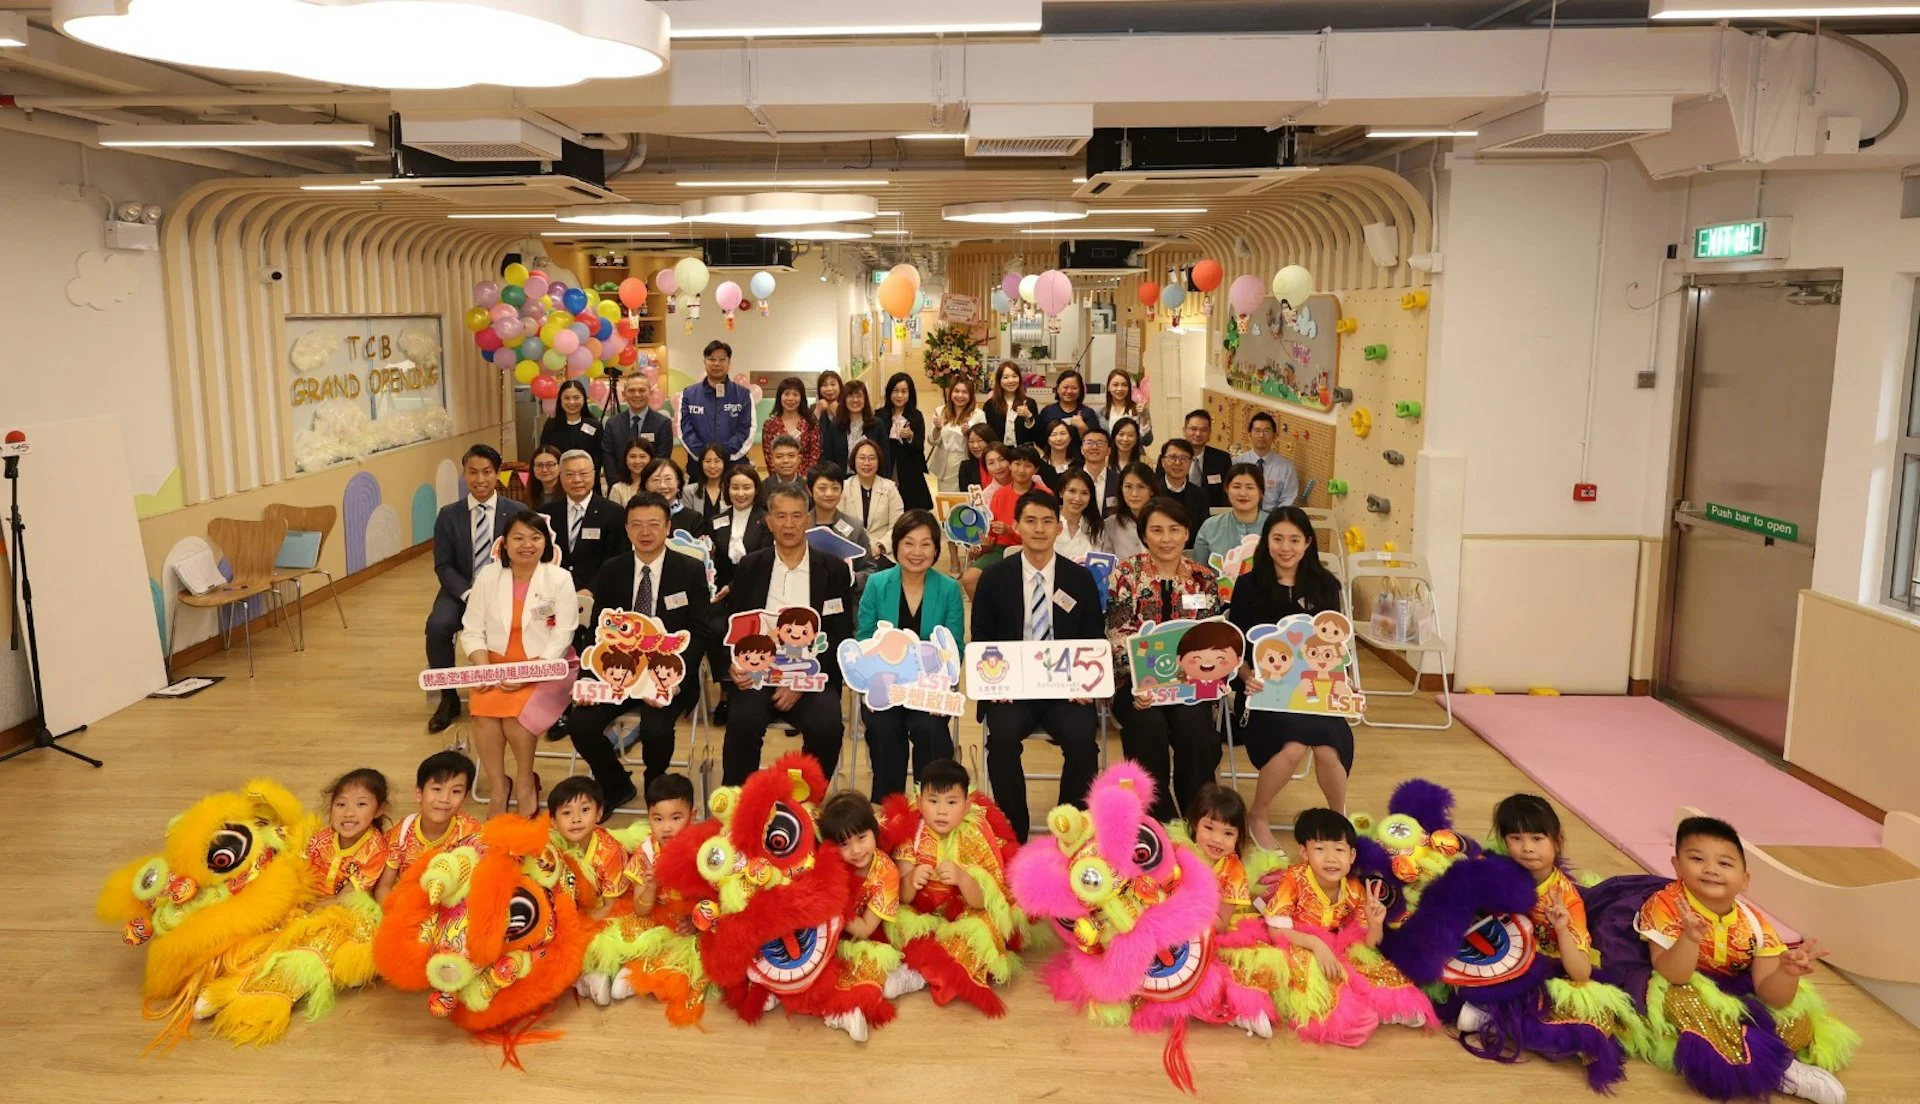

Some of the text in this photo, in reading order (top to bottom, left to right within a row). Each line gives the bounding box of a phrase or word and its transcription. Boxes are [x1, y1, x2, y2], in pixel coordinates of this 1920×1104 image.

[1698, 222, 1764, 257] EXIT 出口
[346, 335, 392, 359] TCB
[291, 364, 439, 406] GRAND OPENING
[1711, 505, 1792, 534] Push bar to open
[577, 683, 609, 700] LST
[793, 675, 826, 690] LST
[918, 672, 951, 690] LST
[1328, 695, 1363, 713] LST
